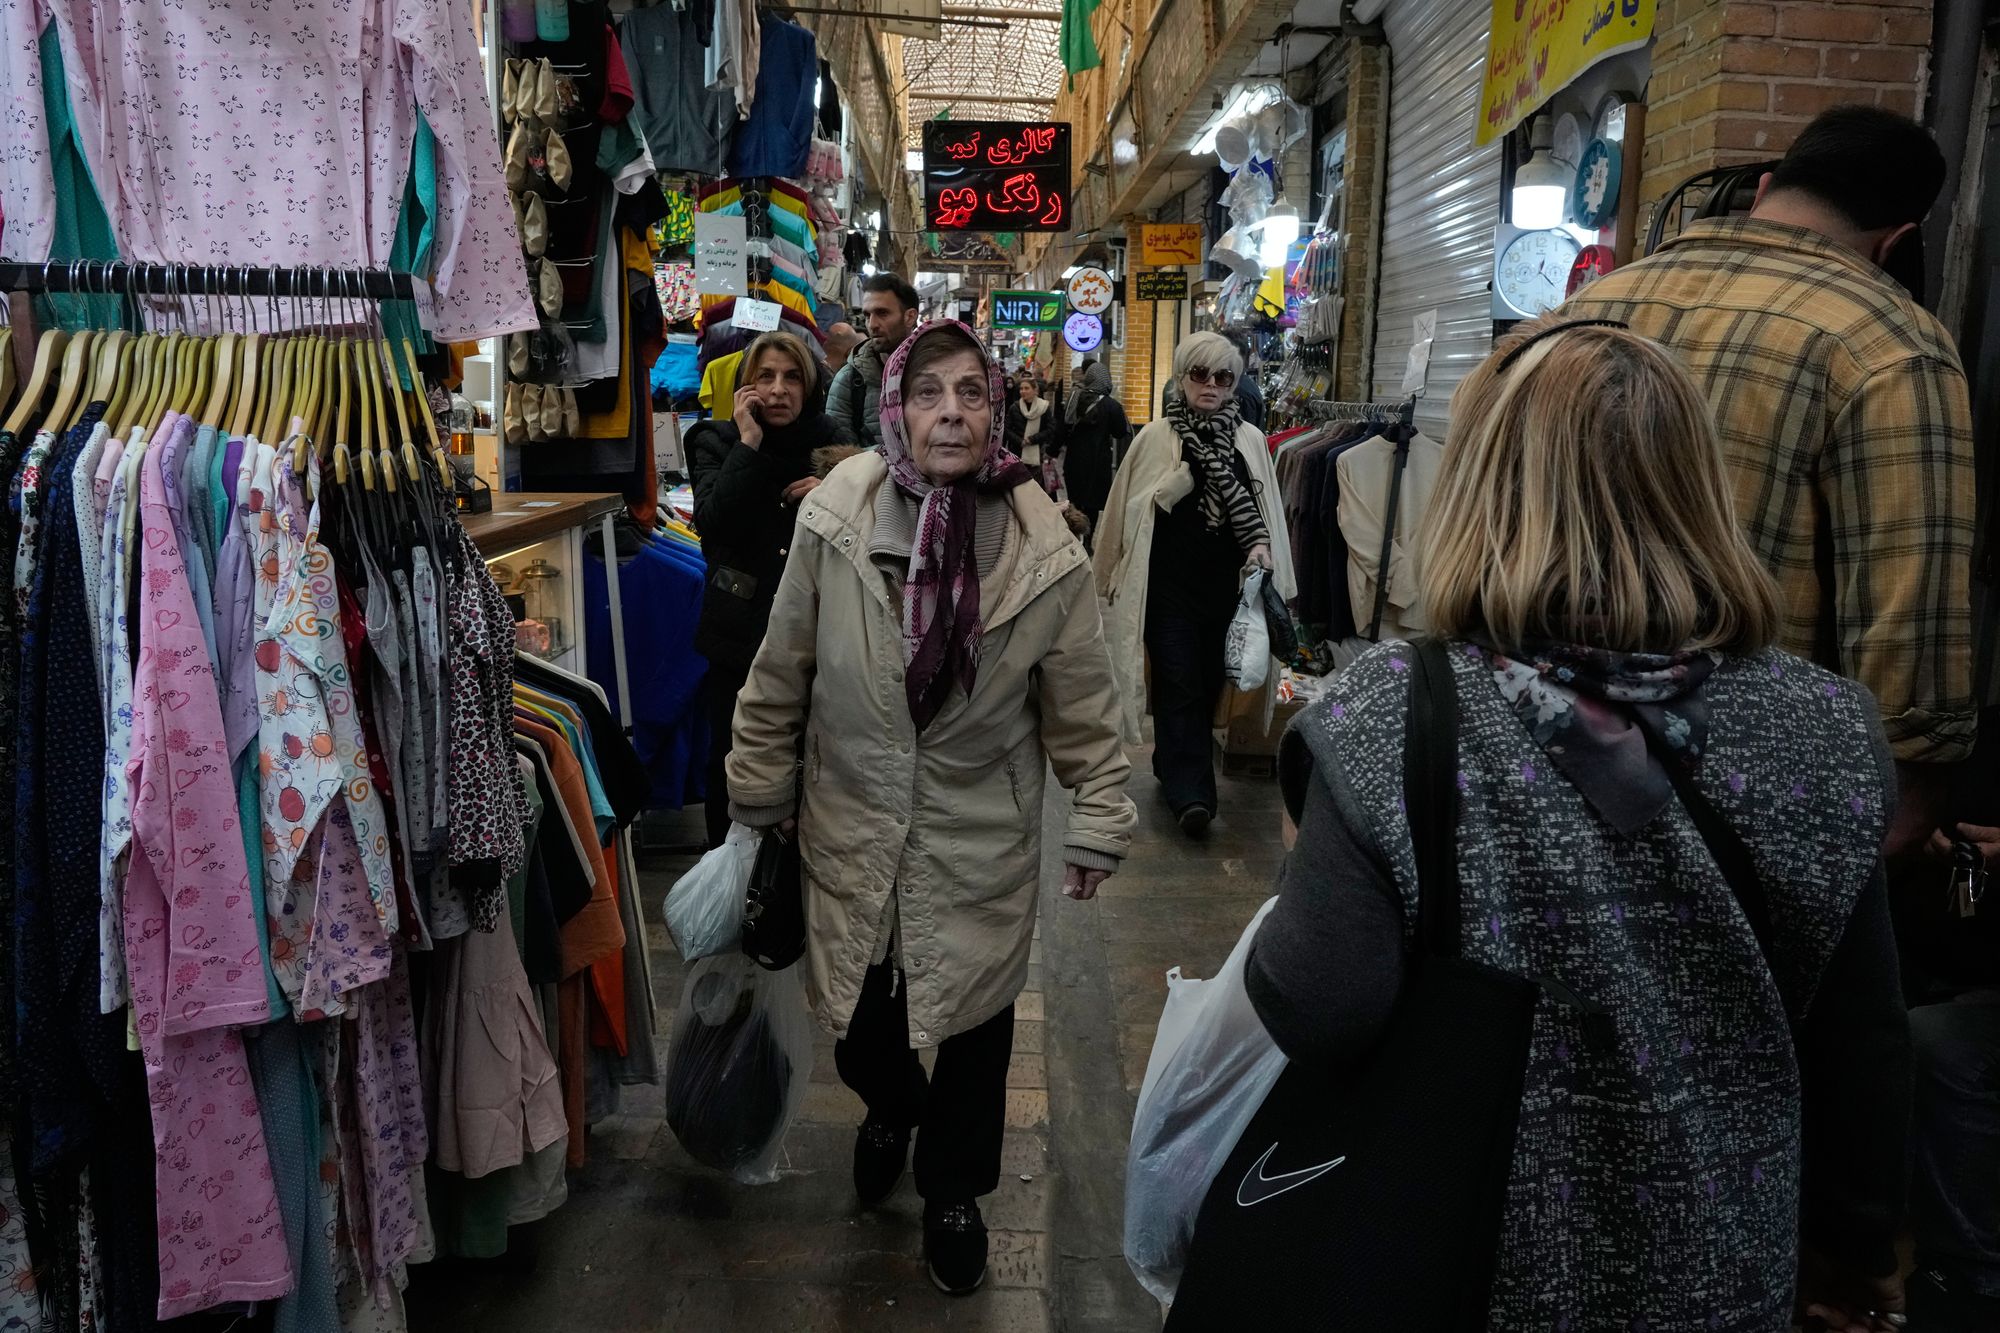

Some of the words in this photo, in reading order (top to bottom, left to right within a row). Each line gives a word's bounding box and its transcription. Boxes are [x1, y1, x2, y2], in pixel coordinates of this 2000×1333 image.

[987, 127, 1056, 165] گالری
[935, 187, 978, 225] مو
[987, 172, 1062, 225] رنگ
[996, 300, 1039, 321] NIRI
